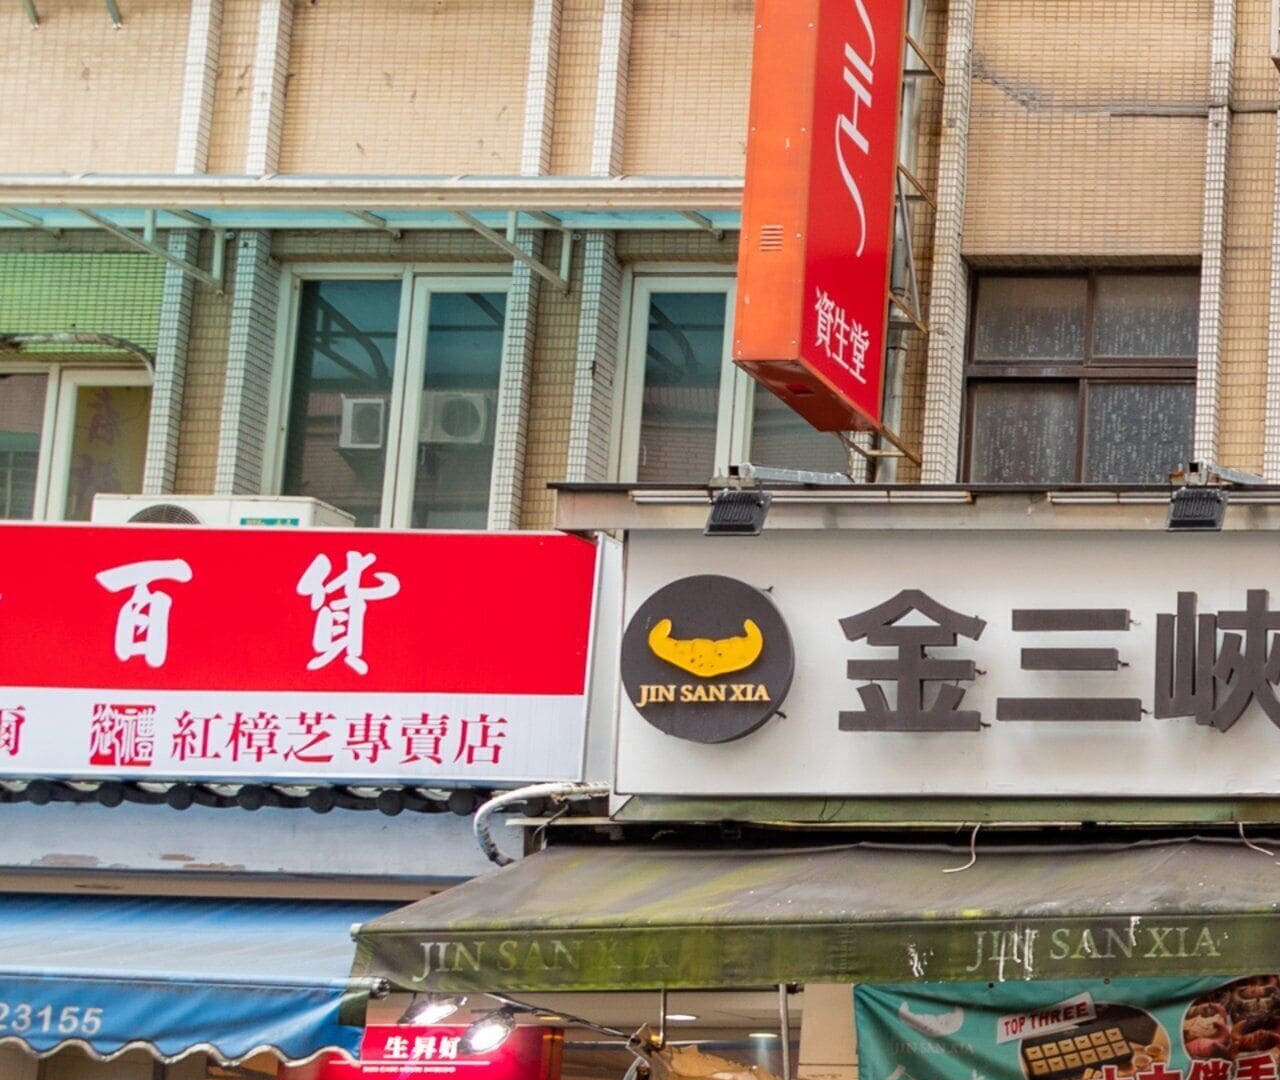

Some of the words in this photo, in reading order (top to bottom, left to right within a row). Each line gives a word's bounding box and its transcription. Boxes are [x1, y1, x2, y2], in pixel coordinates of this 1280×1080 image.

[814, 287, 871, 385] 資生堂
[95, 550, 401, 675] 百貨
[636, 685, 676, 707] JIN
[680, 685, 727, 702] SAN
[729, 684, 771, 702] XIA
[171, 709, 508, 766] 紅樟芝專賣店
[412, 942, 484, 983] JIN
[967, 930, 1038, 971] JIN
[1050, 928, 1134, 960] SAN
[1144, 927, 1221, 959] XIA
[1003, 1015, 1026, 1036] TOP
[1029, 1000, 1089, 1030] THREE
